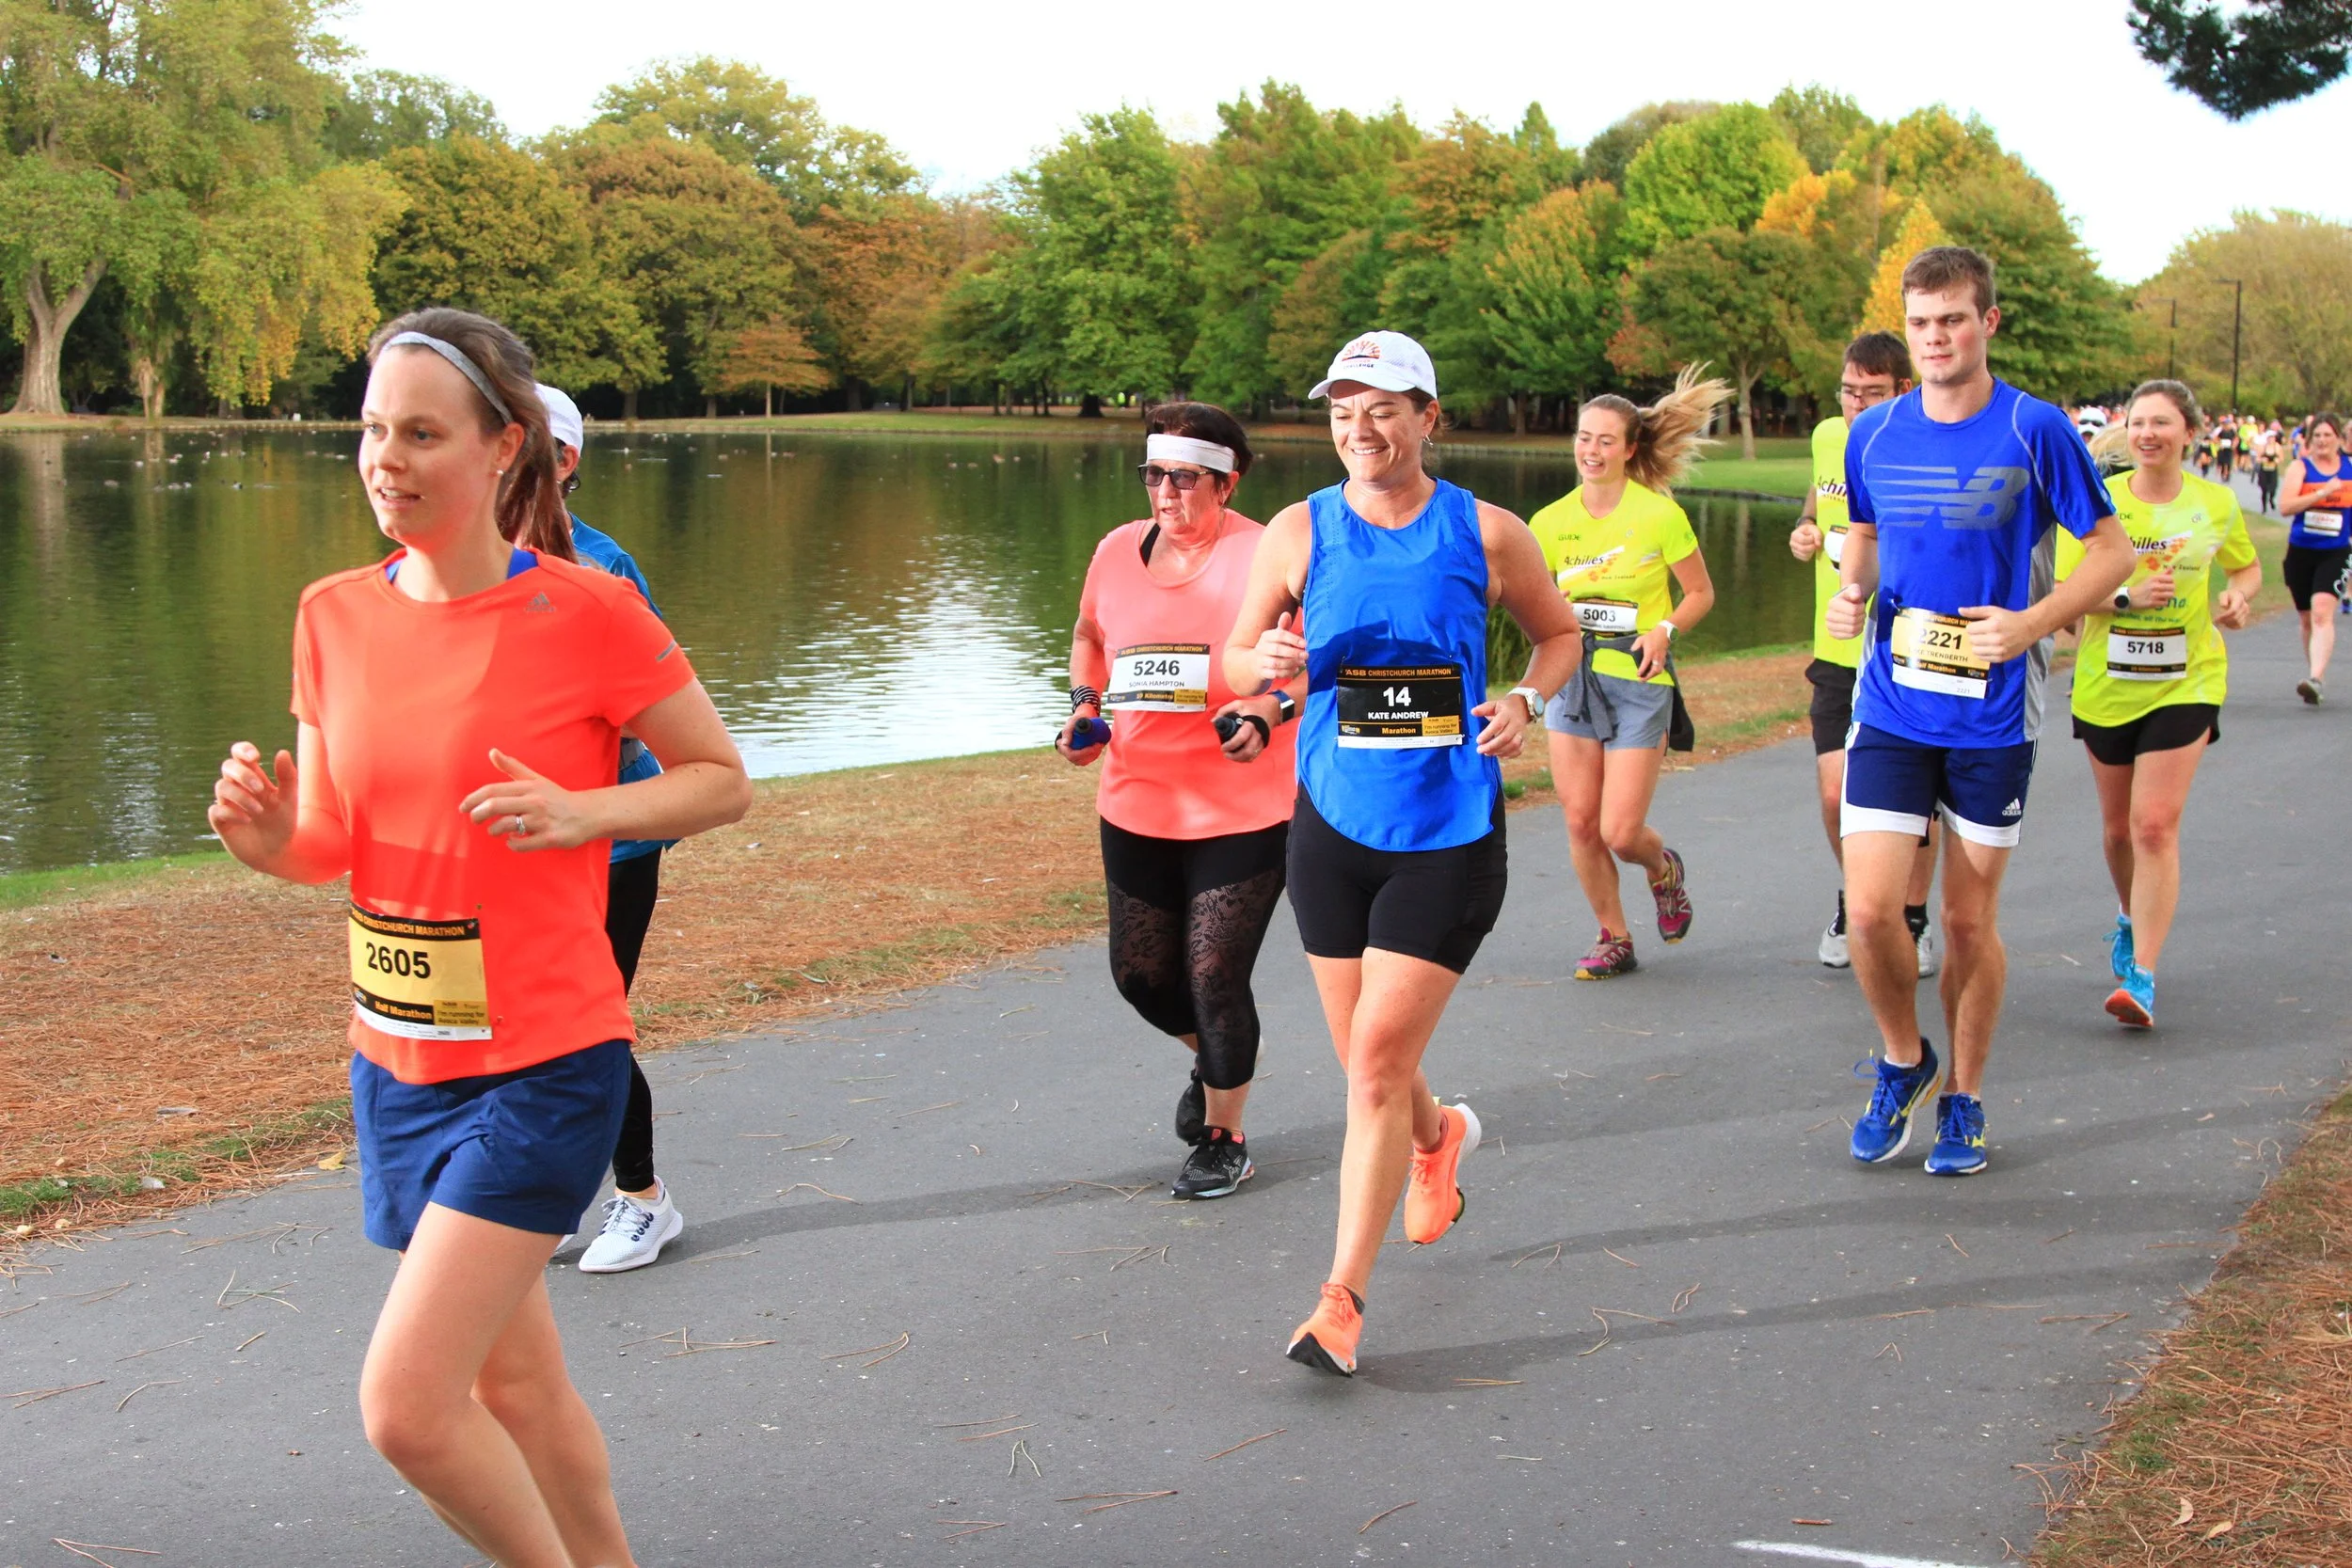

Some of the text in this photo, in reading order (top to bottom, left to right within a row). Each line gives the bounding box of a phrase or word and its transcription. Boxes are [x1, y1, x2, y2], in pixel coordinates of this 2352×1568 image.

[2130, 536, 2167, 549] hilles
[1583, 608, 1616, 623] 5003
[1918, 628, 1963, 650] 2221
[2127, 641, 2164, 654] 5718
[1134, 659, 1181, 676] 5246
[1345, 668, 1367, 676] ASB
[1382, 686, 1412, 707] 14
[1367, 710, 1429, 720] KATE ANDREW
[415, 926, 465, 936] MARATHON
[366, 942, 432, 979] 2605
[389, 1006, 433, 1020] Marathon
